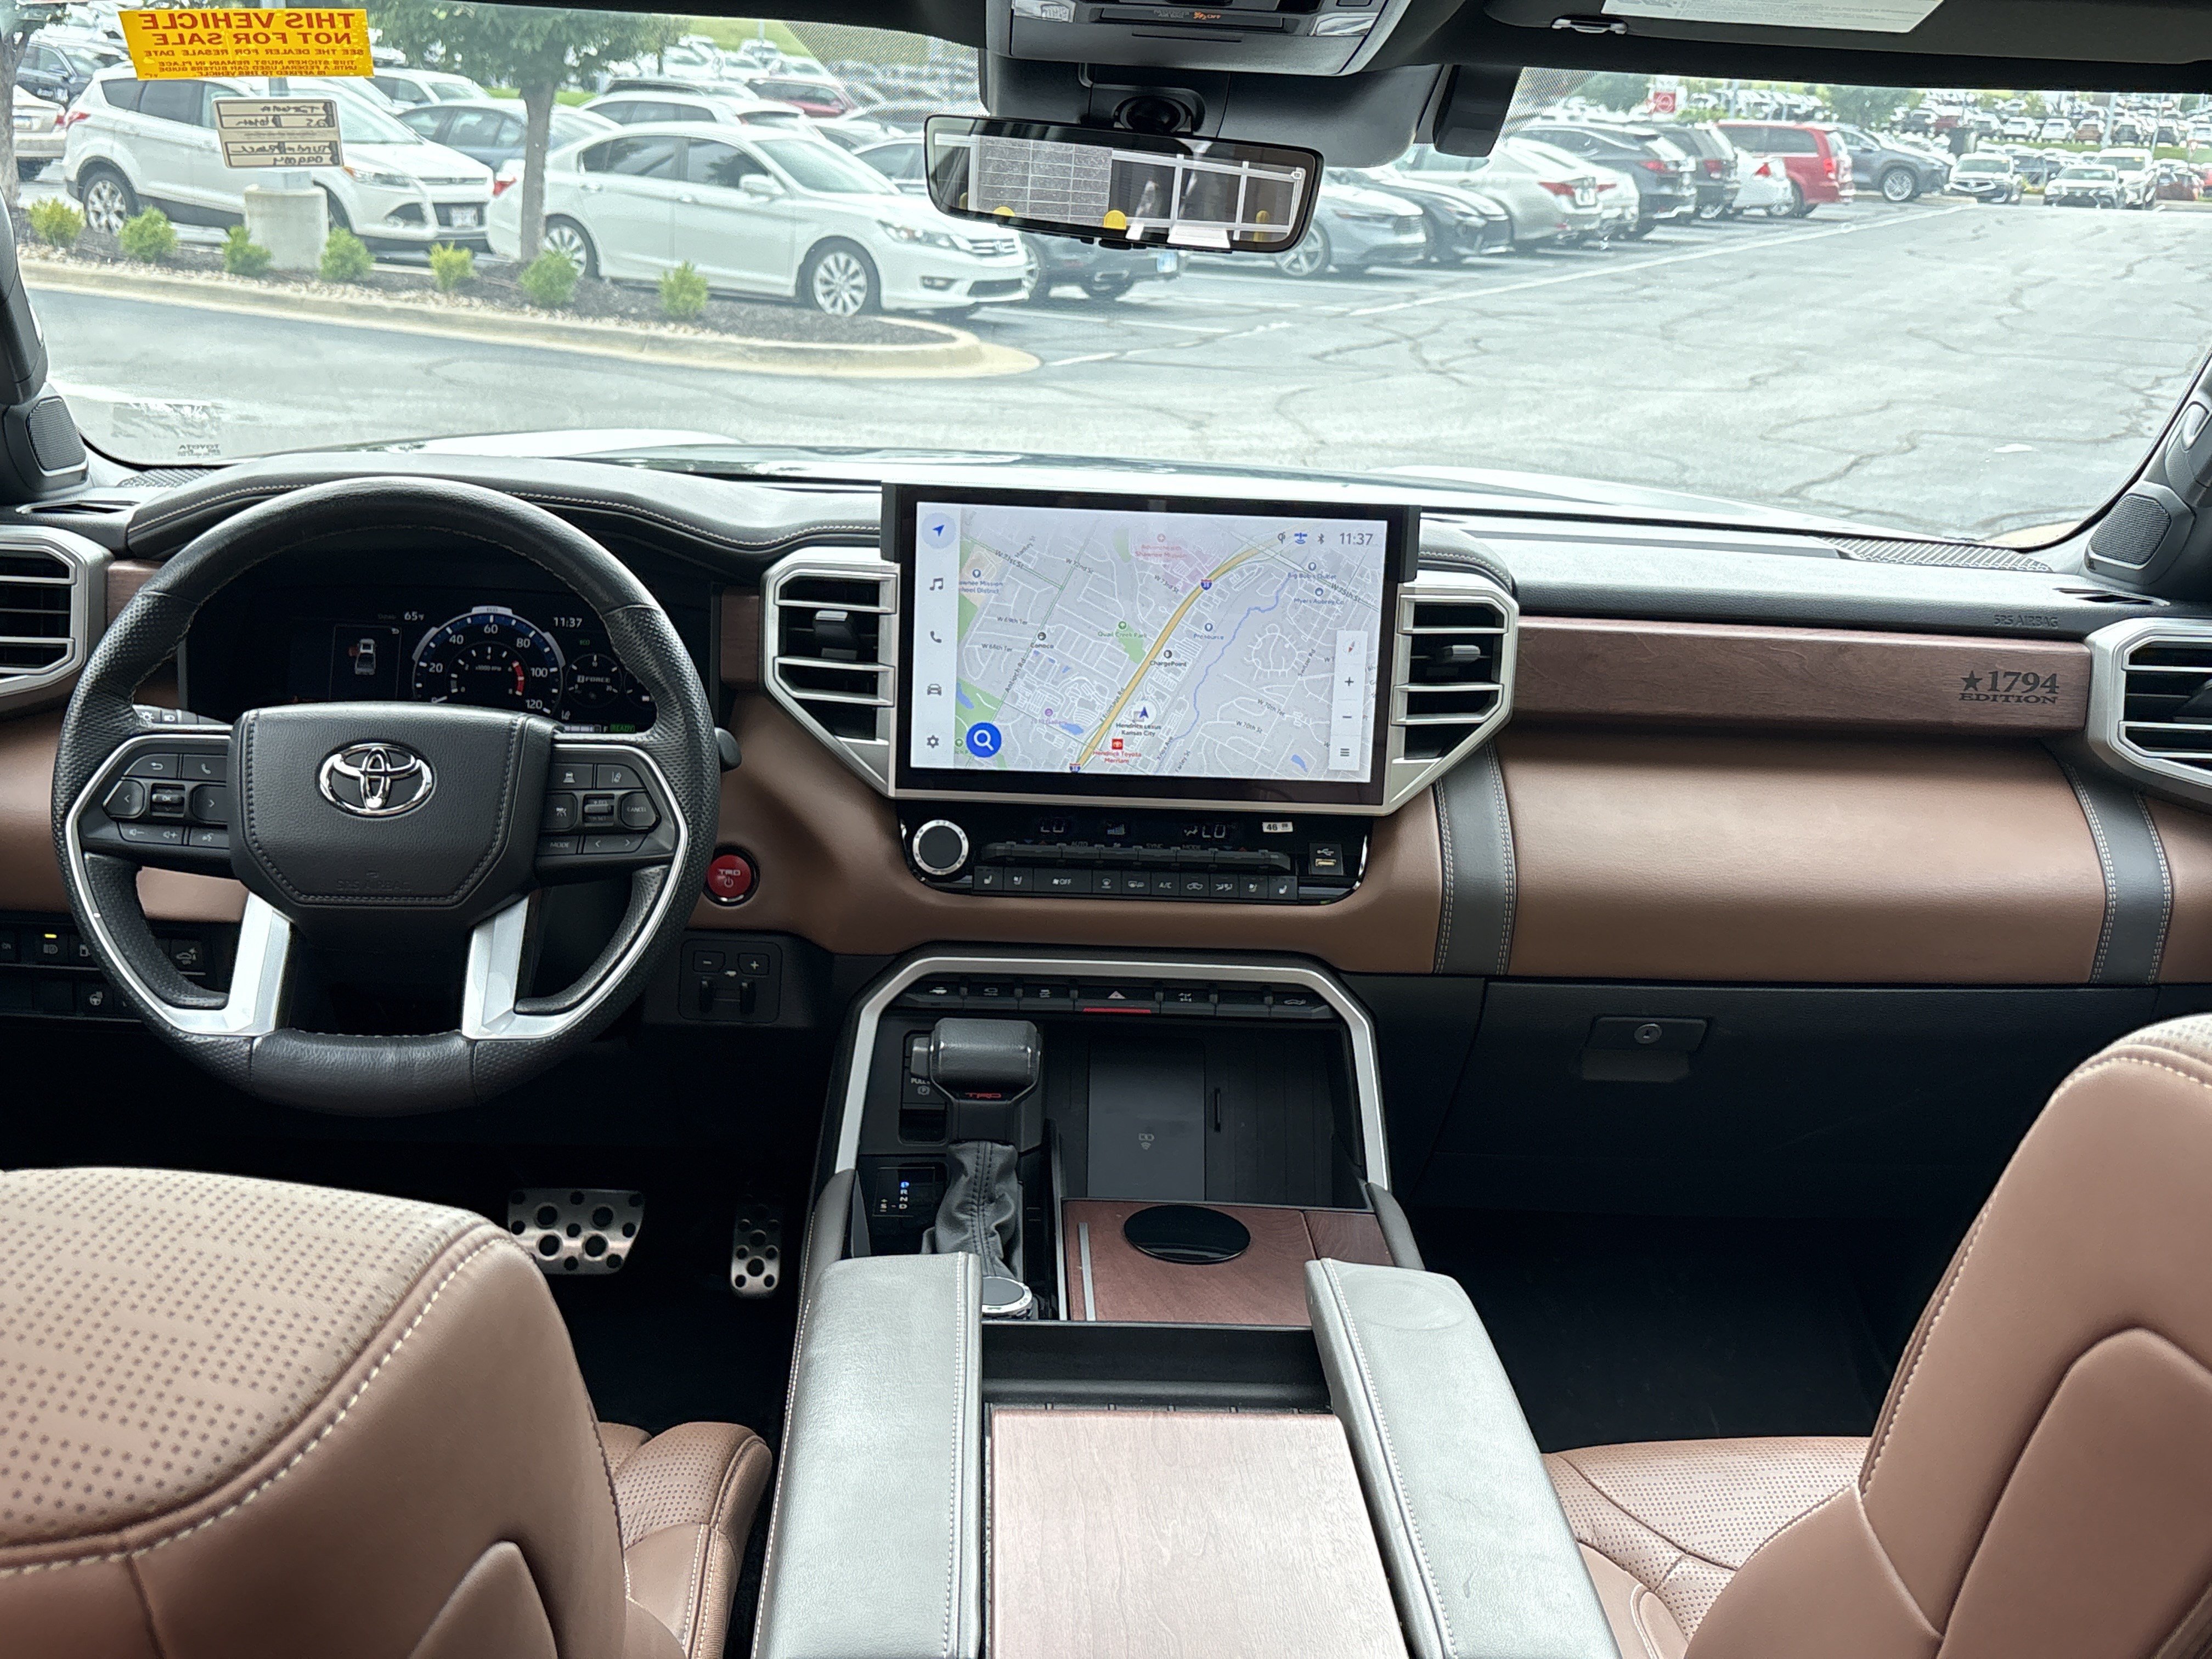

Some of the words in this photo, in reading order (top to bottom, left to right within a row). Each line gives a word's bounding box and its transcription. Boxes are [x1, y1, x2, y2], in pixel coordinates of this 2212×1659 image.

[1339, 532, 1373, 546] 11:37
[554, 617, 583, 628] 11:37
[2016, 615, 2059, 628] AIRBAG
[483, 624, 499, 634] 60
[449, 634, 464, 645] 40
[516, 638, 531, 648] 80
[428, 662, 443, 673] 20
[530, 667, 548, 678] 100
[1005, 665, 1022, 693] Antioch
[1018, 658, 1026, 667] Rd
[1988, 670, 2059, 695] 1794
[1959, 692, 2058, 704] EDITION
[525, 699, 543, 710] 120
[611, 724, 635, 732] READY
